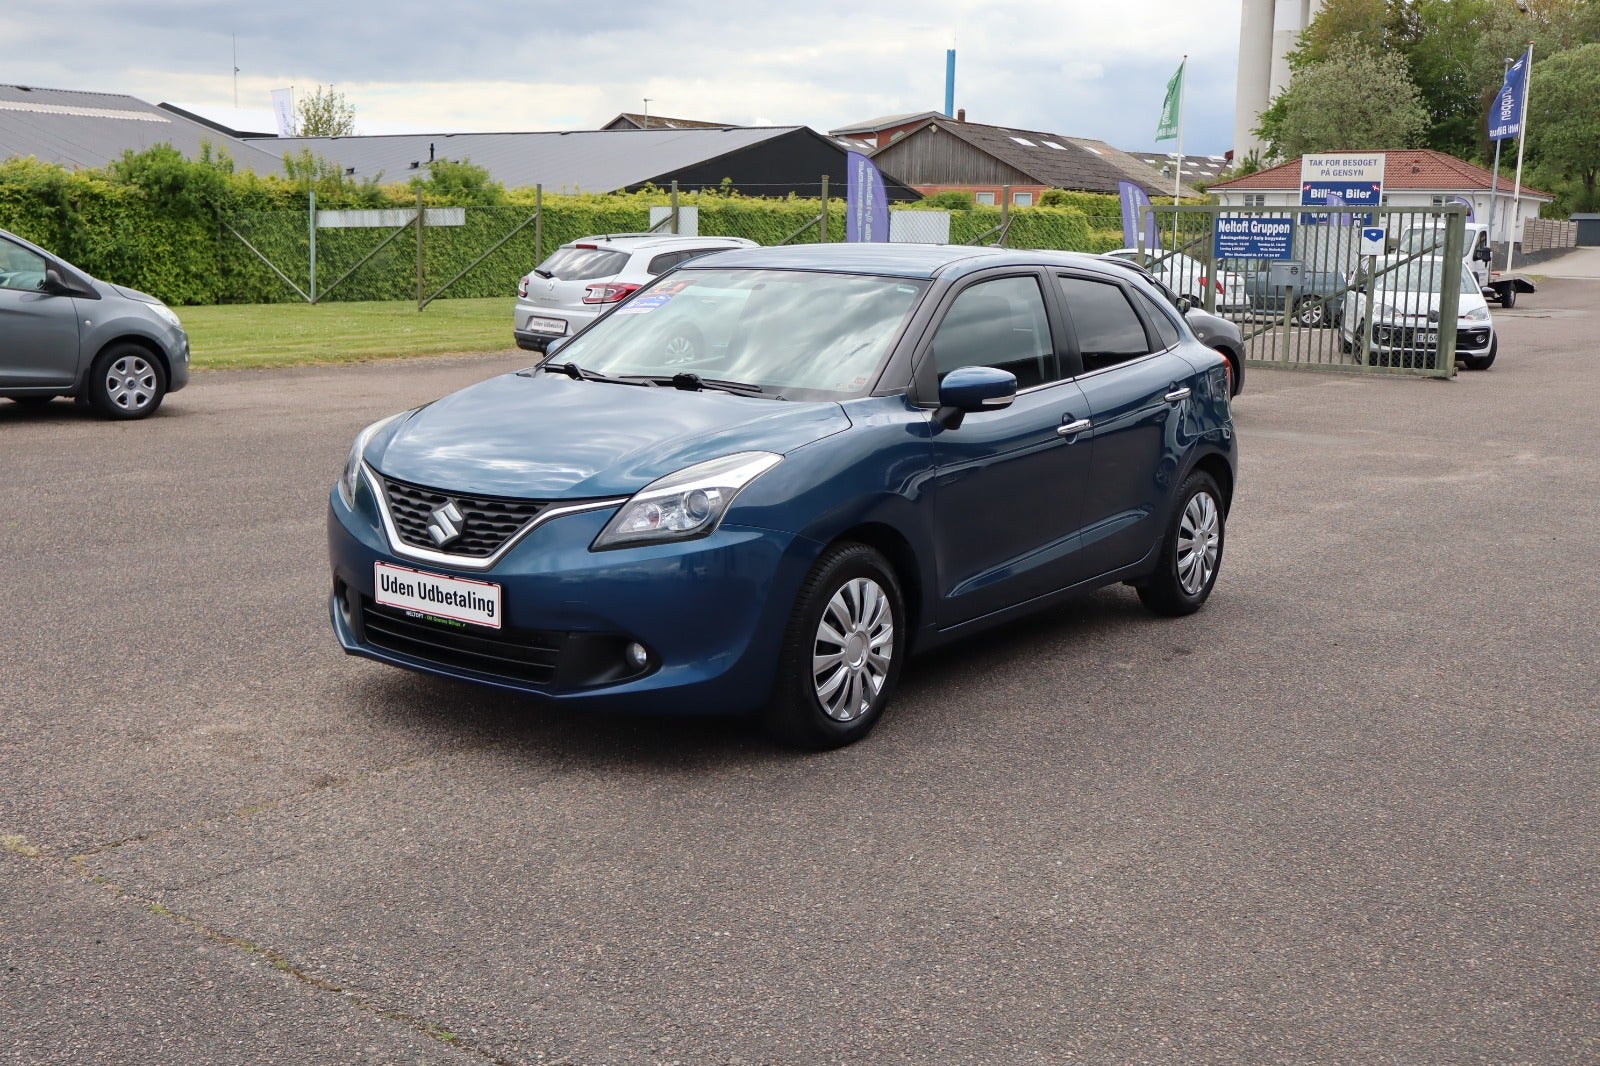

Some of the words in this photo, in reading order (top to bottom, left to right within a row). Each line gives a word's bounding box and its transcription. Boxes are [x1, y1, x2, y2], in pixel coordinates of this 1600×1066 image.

[1320, 168, 1330, 176] PÅ
[1310, 189, 1343, 198] Bille
[1345, 189, 1372, 199] Biler
[1218, 219, 1249, 233] Neltoft
[1250, 220, 1290, 236] Gruppen
[381, 573, 414, 597] Uden
[417, 581, 495, 617] Udbetaling
